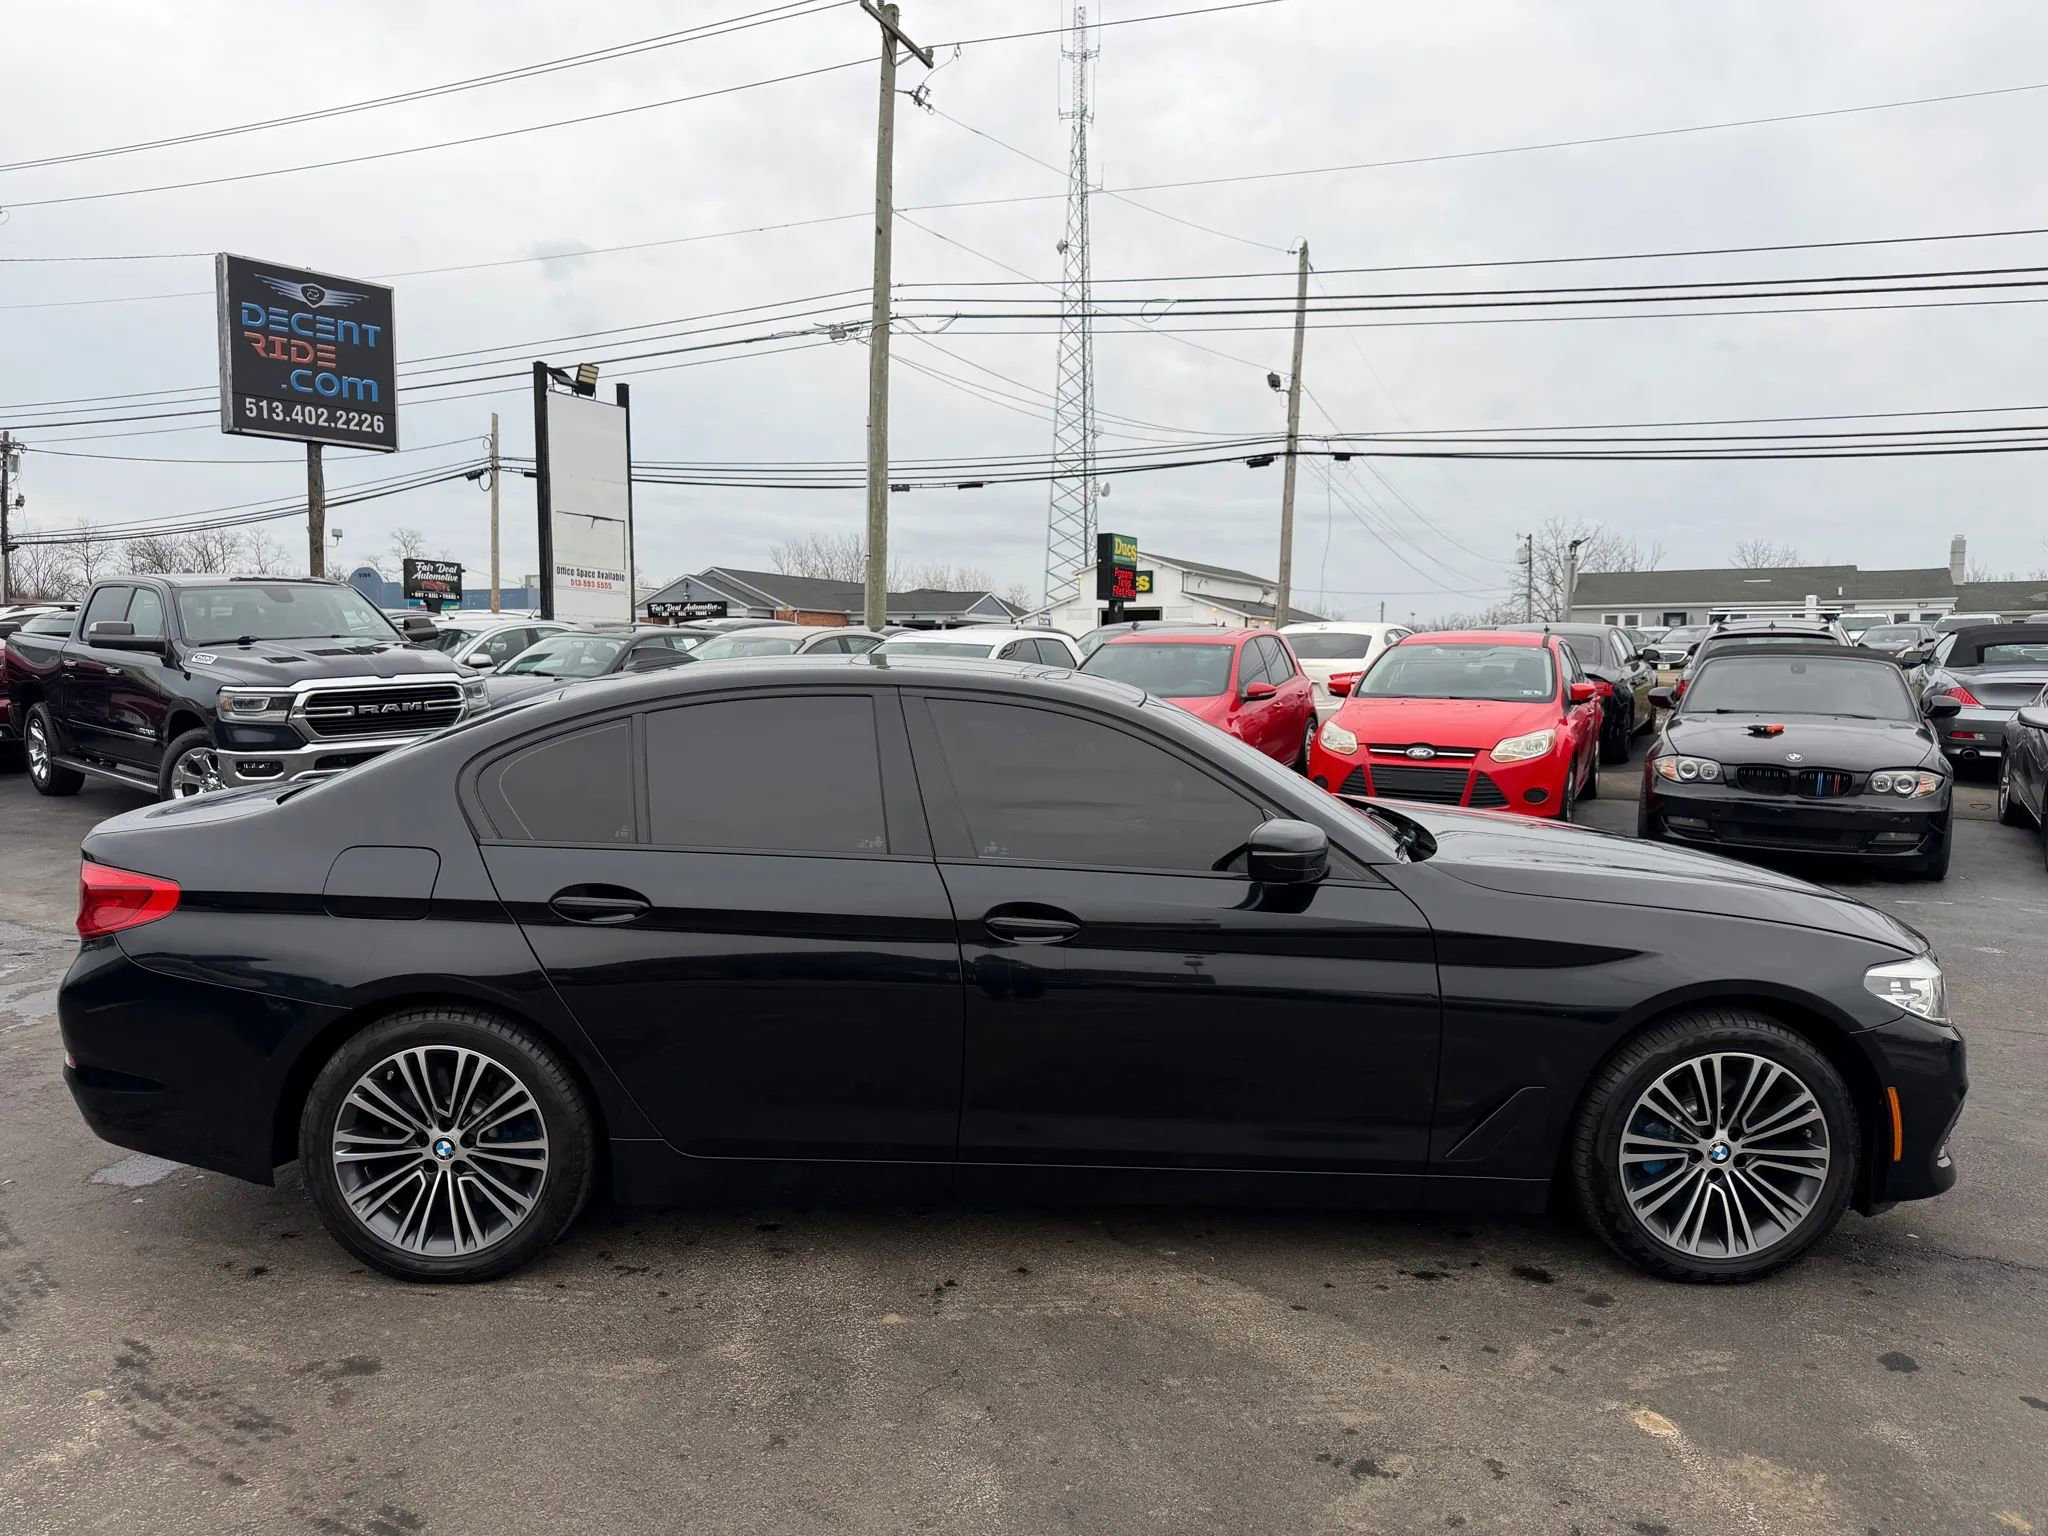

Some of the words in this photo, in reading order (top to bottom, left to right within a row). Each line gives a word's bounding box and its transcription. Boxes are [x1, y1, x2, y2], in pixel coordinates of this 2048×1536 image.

[241, 302, 381, 347] DECENT
[243, 332, 336, 368] RIDE
[245, 398, 385, 433] 513.402.2226
[415, 562, 434, 572] Fair
[436, 563, 458, 574] Deal
[556, 566, 575, 576] Office
[576, 568, 596, 579] Space
[597, 570, 625, 582] Available
[412, 570, 459, 582] Automotive
[650, 603, 665, 613] Fair
[665, 603, 682, 612] Deal
[683, 603, 718, 612] Automotive
[358, 701, 422, 715] RAM
